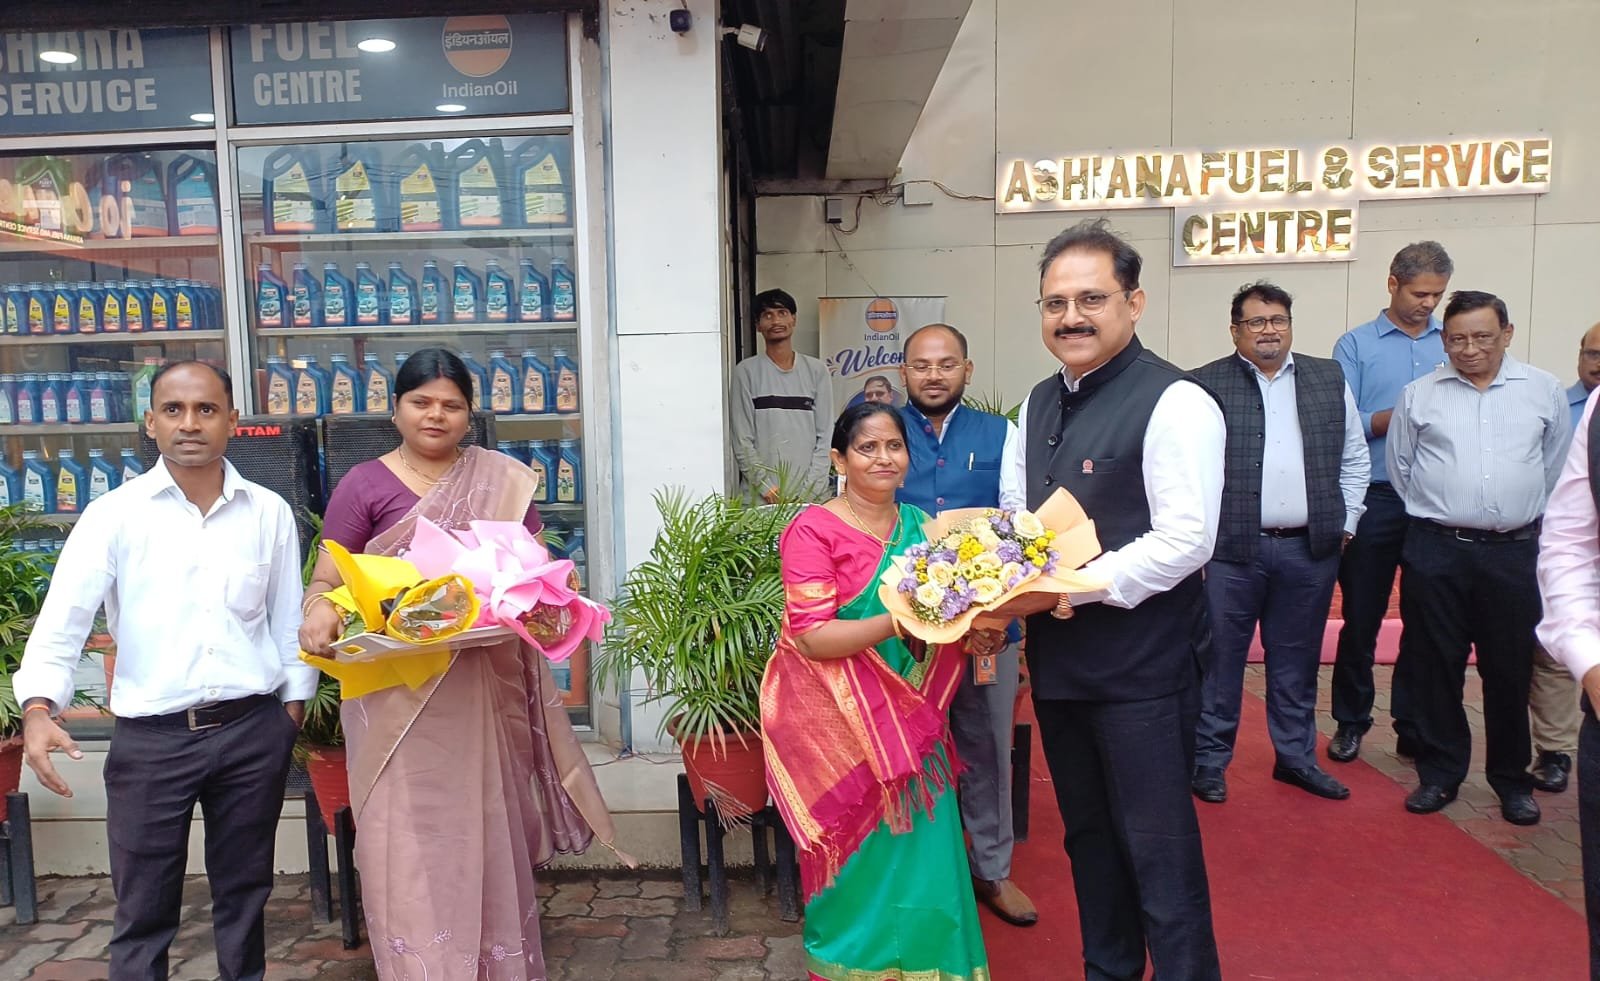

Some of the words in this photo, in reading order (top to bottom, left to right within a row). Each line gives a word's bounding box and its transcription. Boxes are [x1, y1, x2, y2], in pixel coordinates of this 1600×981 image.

[250, 21, 360, 62] FUEL
[253, 69, 362, 106] CENTRE
[443, 80, 518, 98] IndianOil
[1005, 154, 1193, 203] ASHIANA
[1200, 149, 1312, 195] FUEL
[1322, 146, 1353, 190] &
[1367, 139, 1549, 189] SERVICE
[1183, 208, 1352, 256] CENTRE
[864, 332, 900, 341] IndianOil
